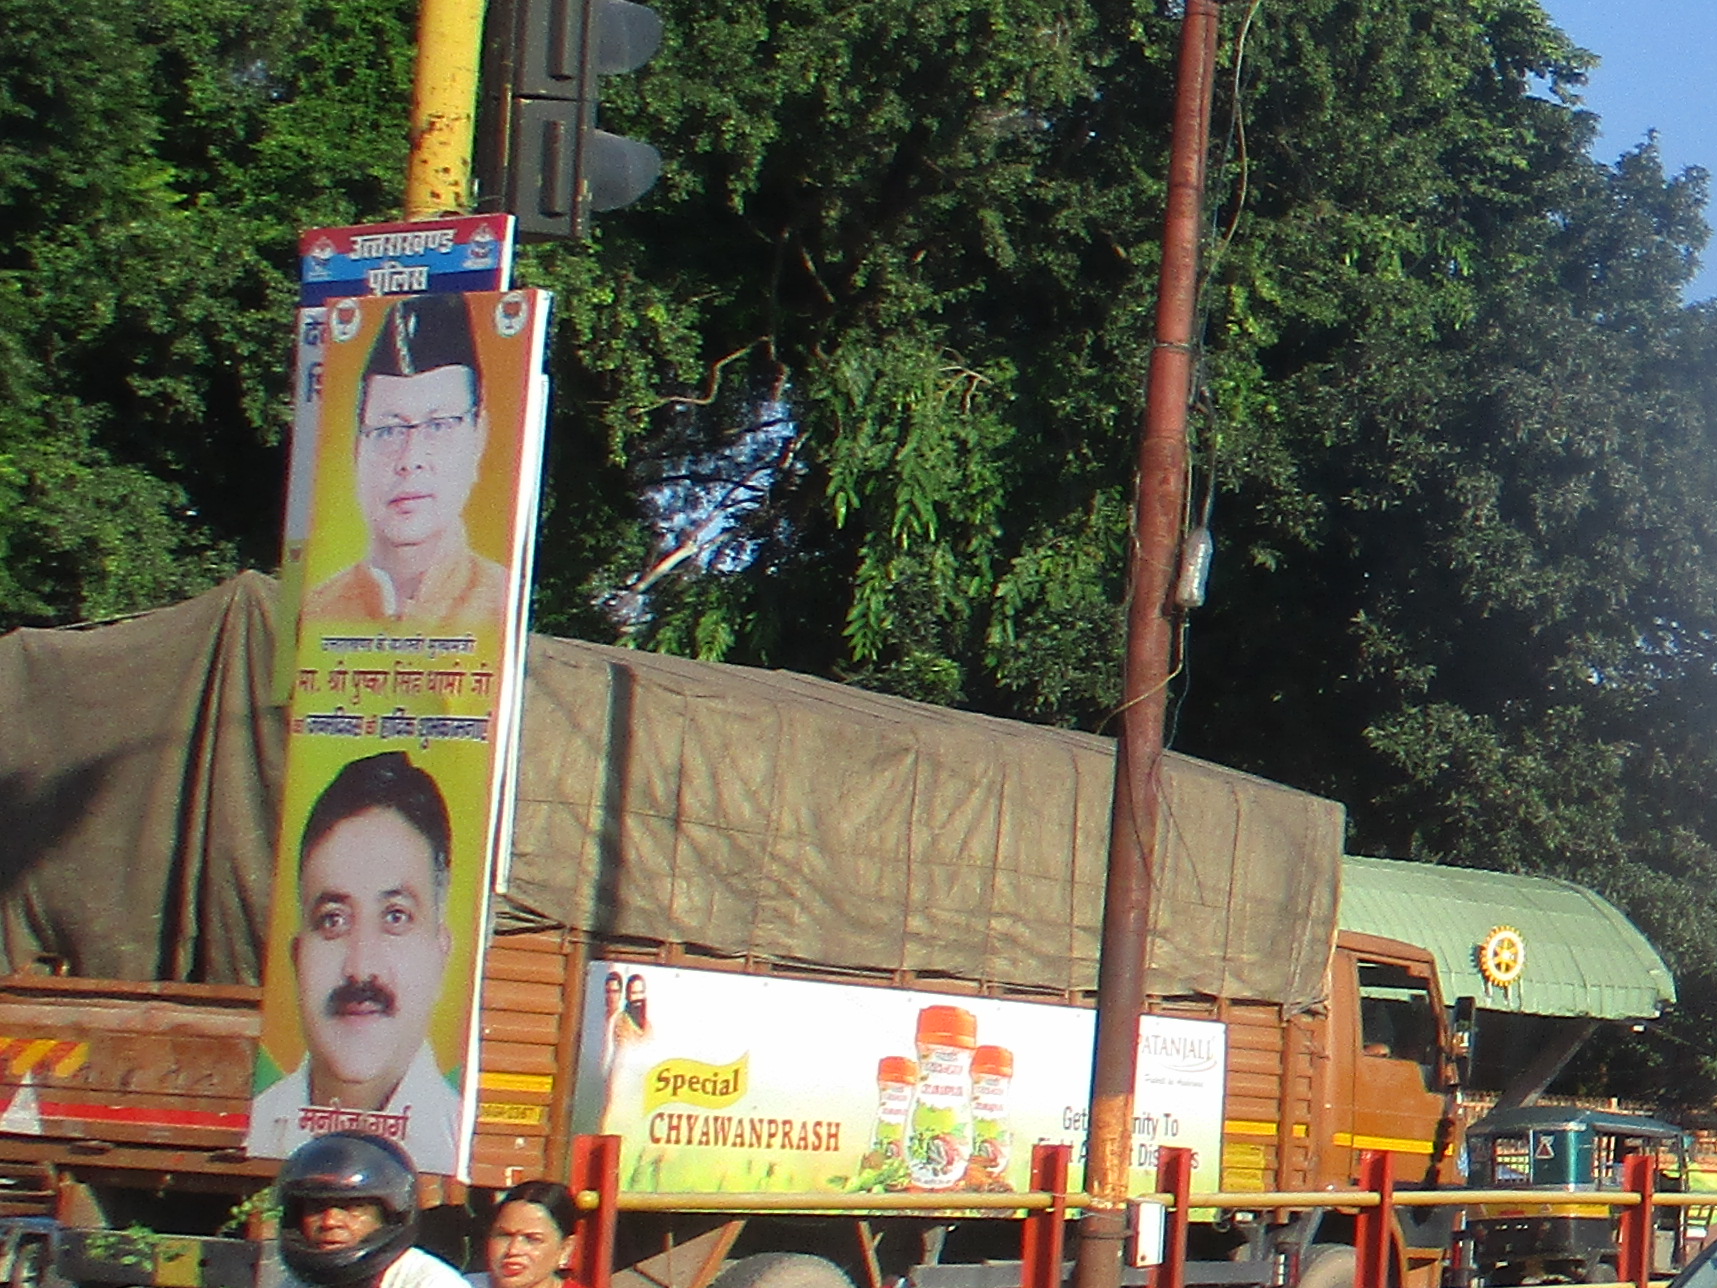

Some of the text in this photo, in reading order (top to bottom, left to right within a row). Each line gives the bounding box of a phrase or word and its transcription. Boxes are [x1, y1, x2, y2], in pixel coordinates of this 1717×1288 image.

[367, 261, 430, 296] पुलिस
[654, 1063, 741, 1100] Special
[648, 1114, 842, 1154] CHYAWANPRASH
[1062, 1106, 1089, 1131] Get
[1163, 1112, 1179, 1137] To
